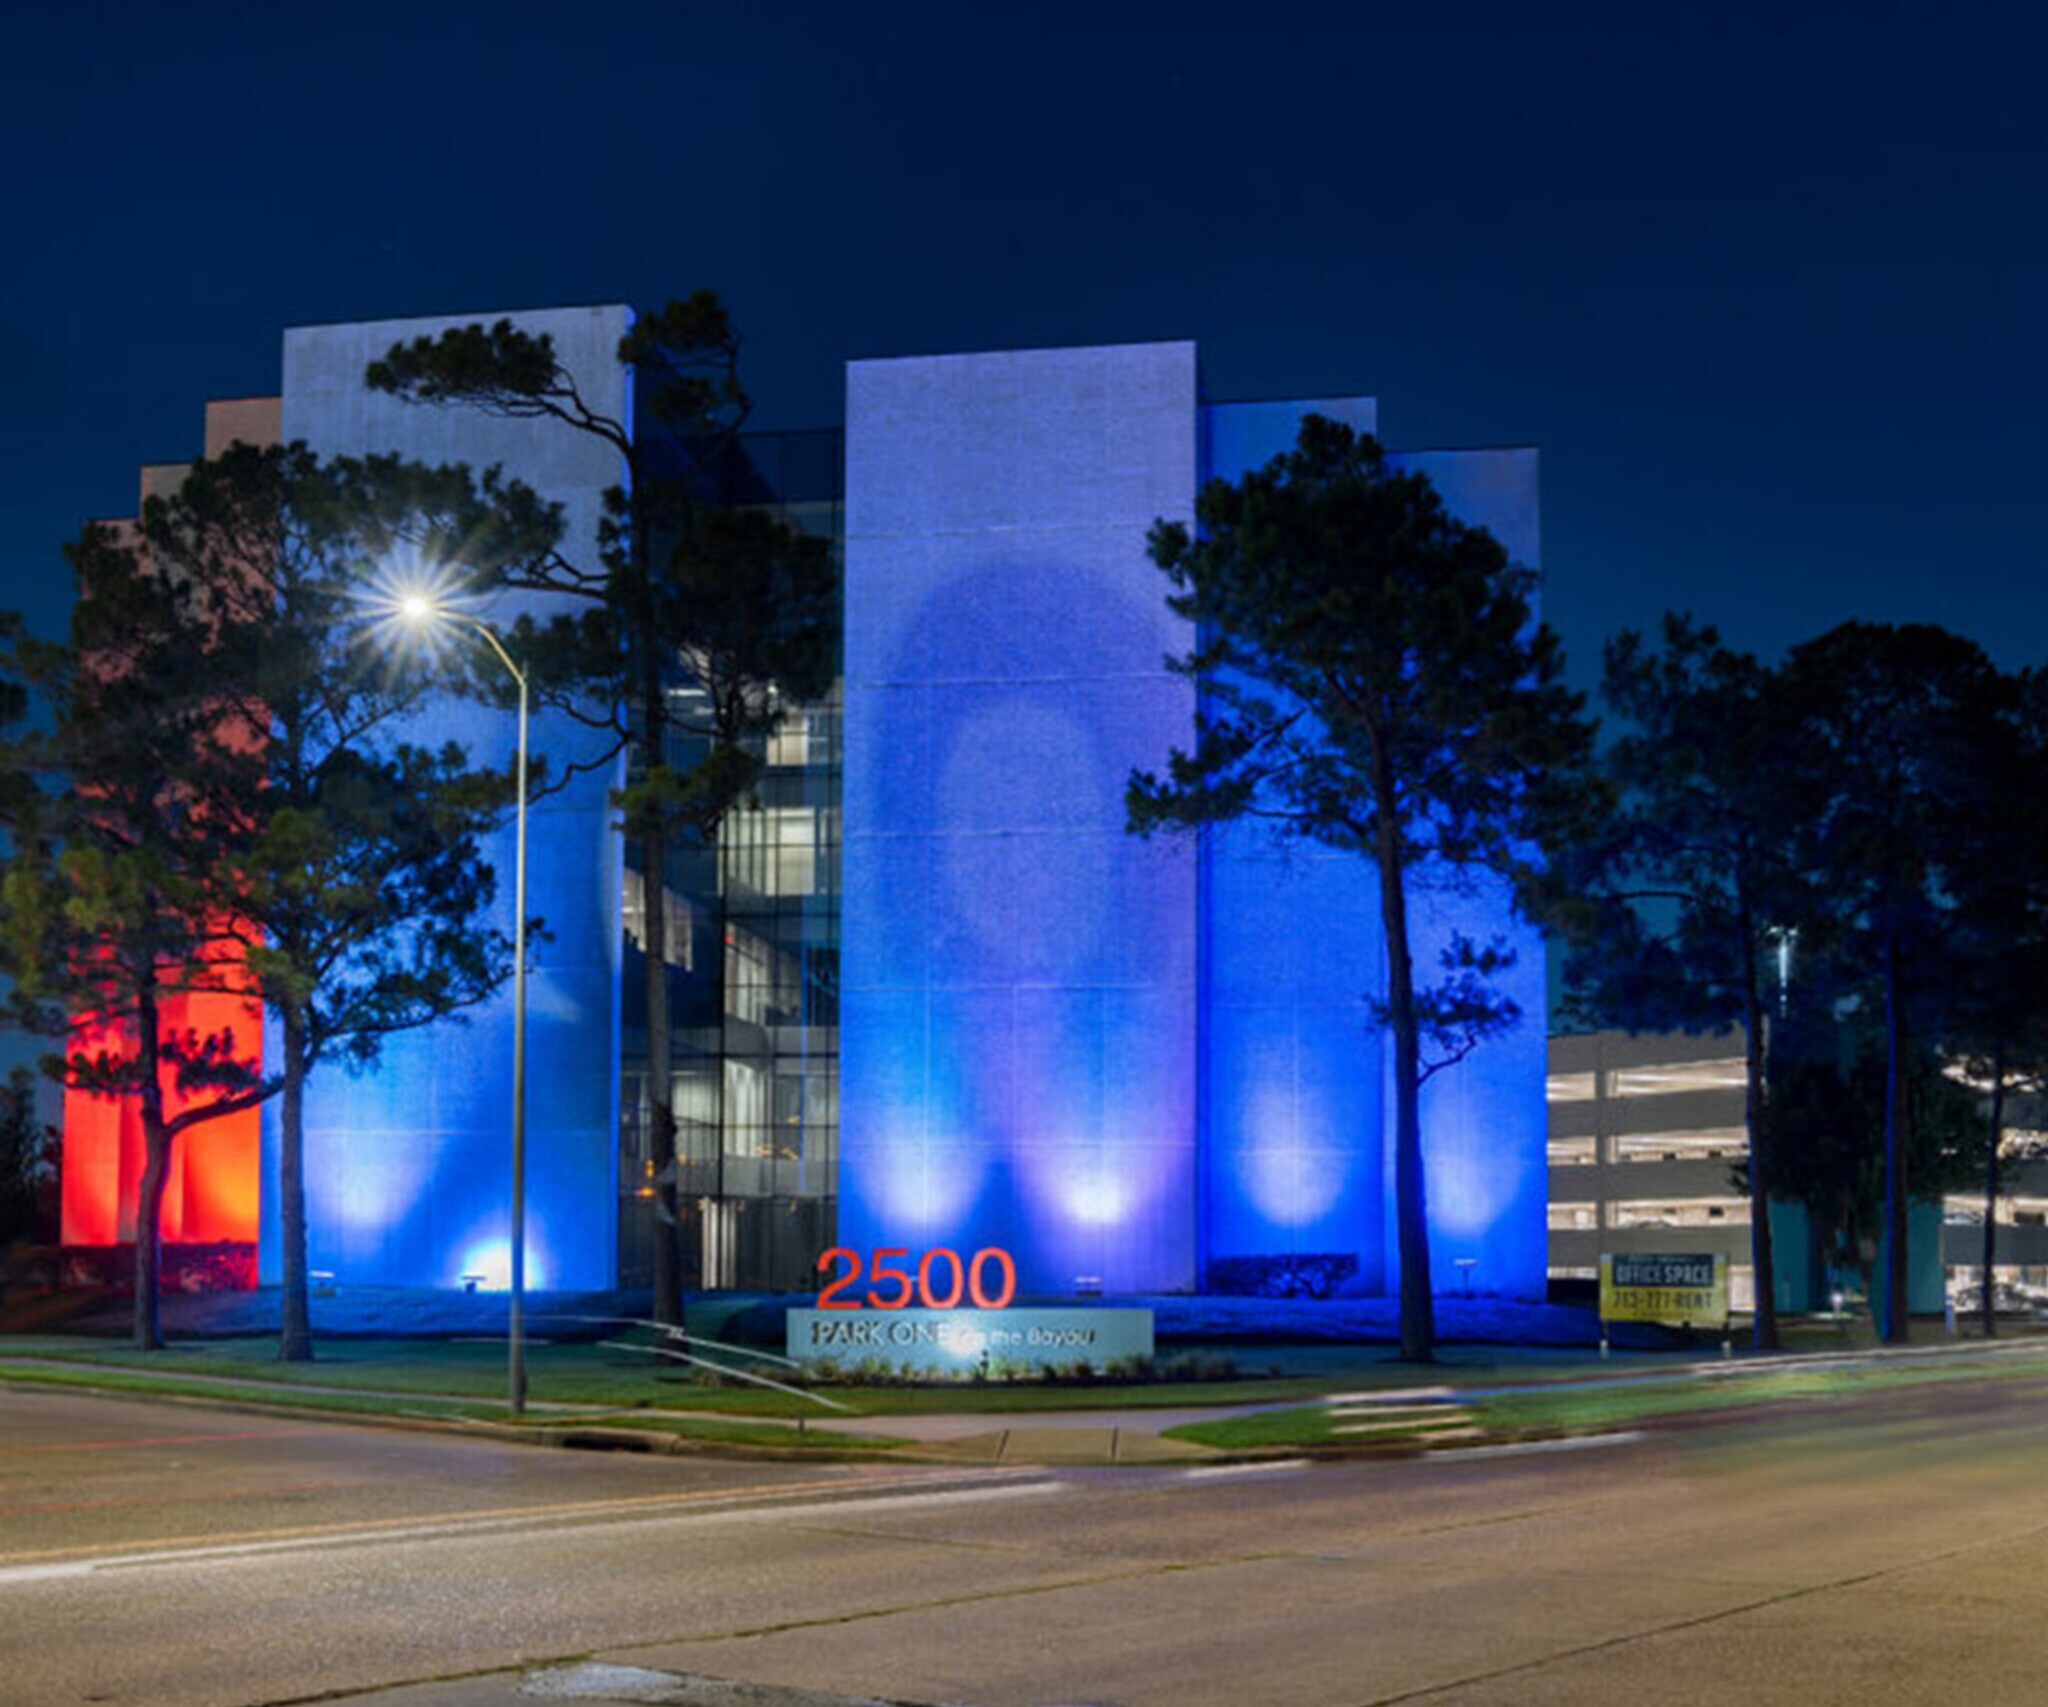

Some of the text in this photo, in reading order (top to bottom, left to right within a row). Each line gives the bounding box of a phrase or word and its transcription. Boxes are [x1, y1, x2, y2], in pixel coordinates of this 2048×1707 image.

[817, 1246, 1016, 1309] 2500
[1616, 1264, 1709, 1283] OFFICE SPACE
[813, 1321, 884, 1346] PARK
[888, 1321, 952, 1346] ONE
[989, 1328, 1021, 1346] the
[1027, 1326, 1095, 1348] Bayou
